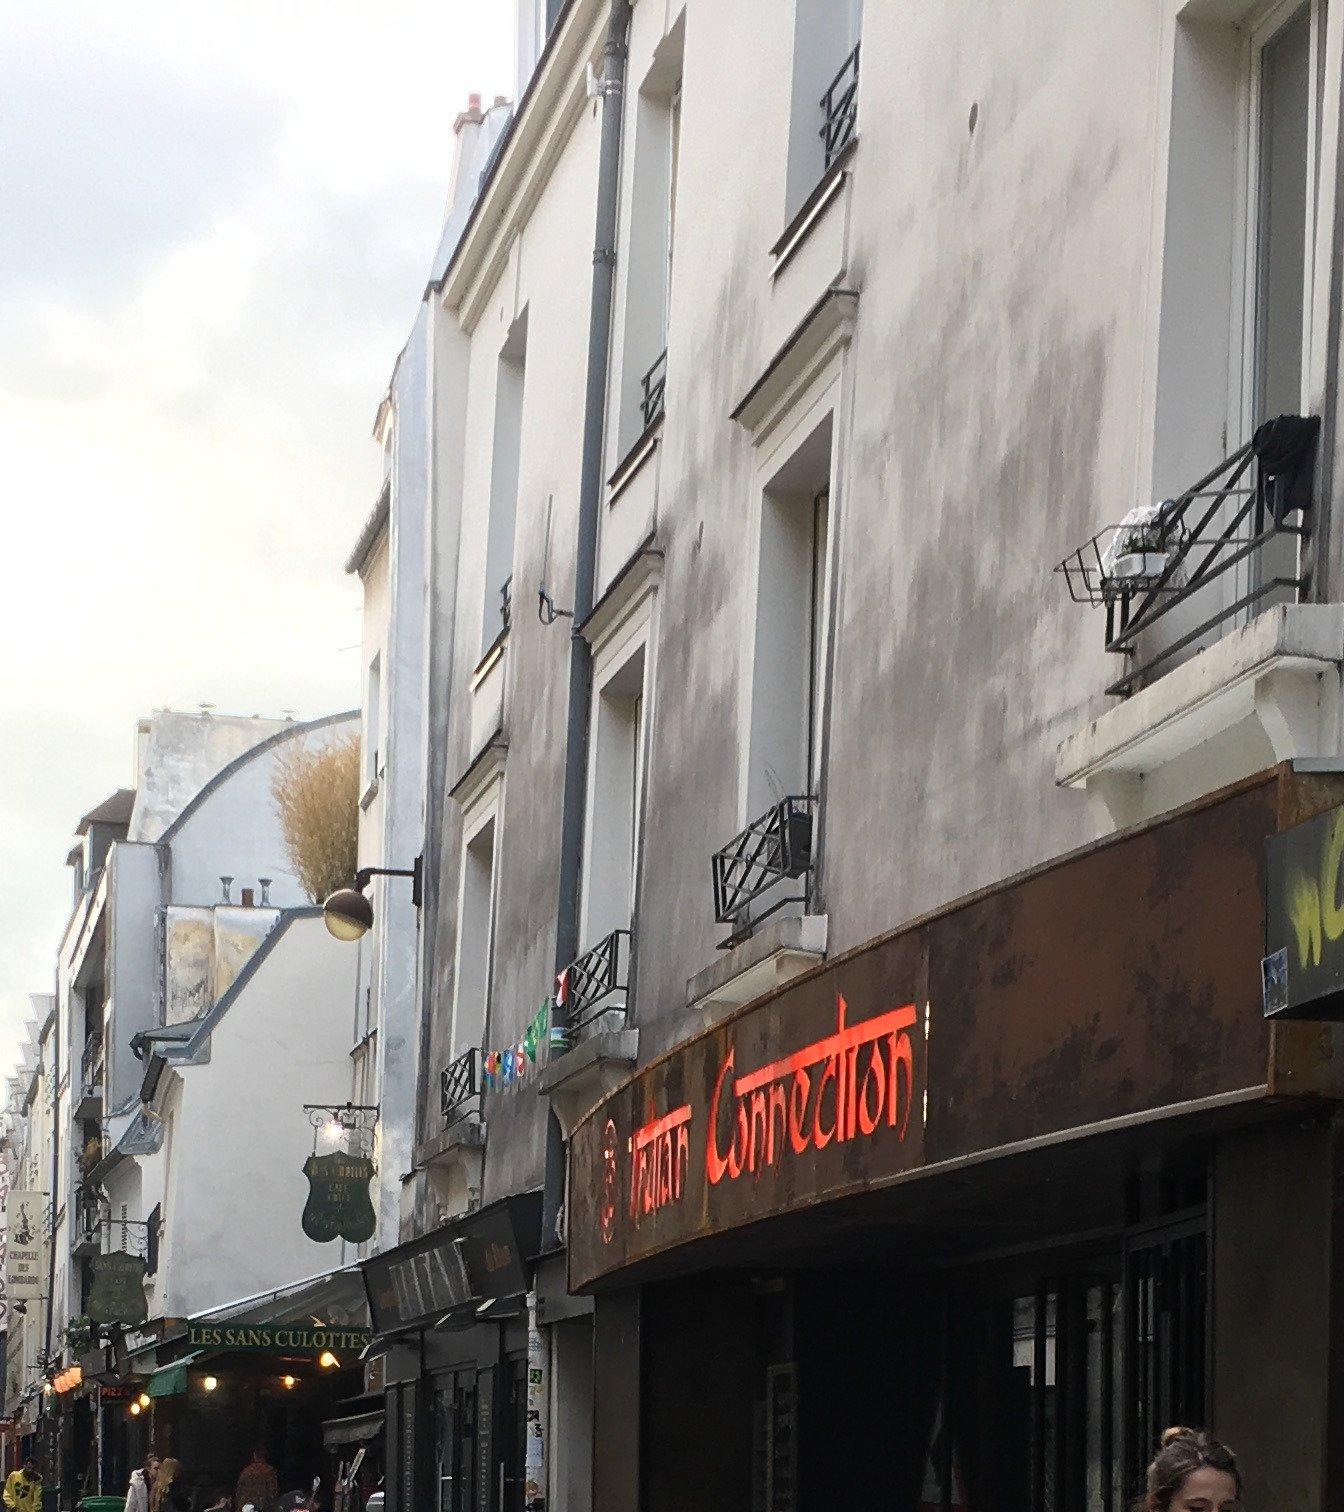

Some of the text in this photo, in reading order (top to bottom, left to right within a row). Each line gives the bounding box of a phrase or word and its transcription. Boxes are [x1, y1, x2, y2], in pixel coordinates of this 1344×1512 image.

[705, 993, 917, 1186] Connection
[188, 1327, 371, 1349] LES SANS CULOTTES
